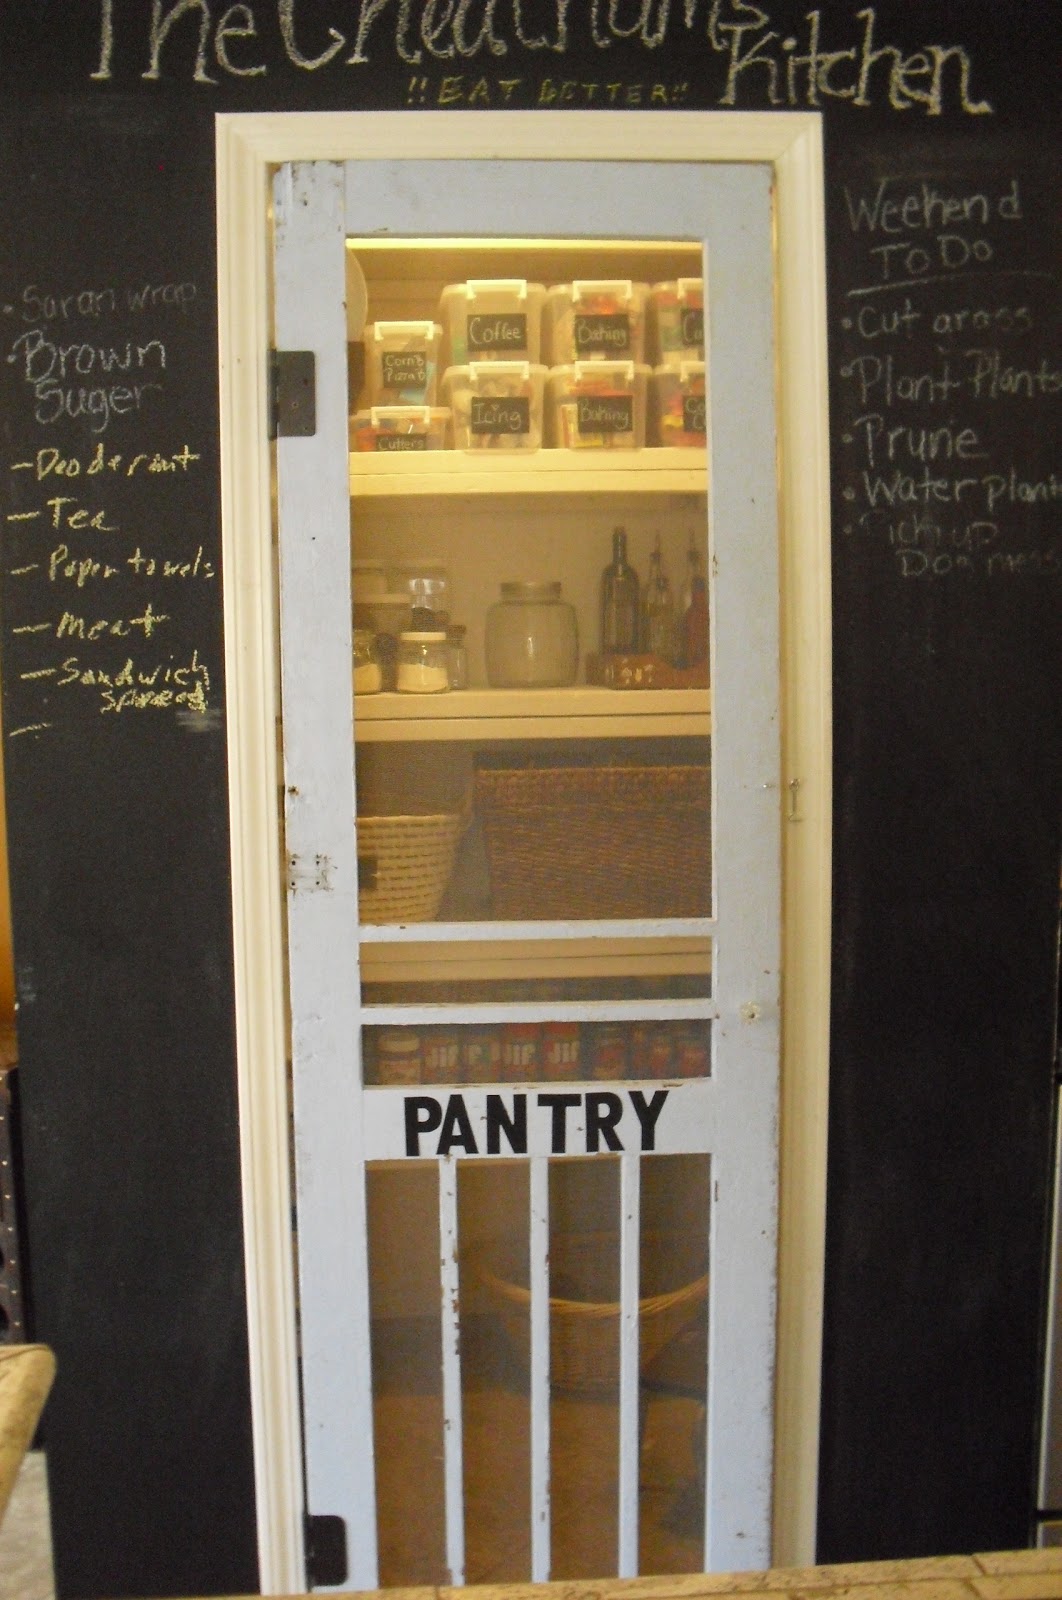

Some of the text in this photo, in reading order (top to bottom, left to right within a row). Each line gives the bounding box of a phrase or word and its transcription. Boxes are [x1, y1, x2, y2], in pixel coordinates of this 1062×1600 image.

[719, 8, 993, 116] Kitchen
[469, 317, 521, 345] Coffee
[858, 299, 920, 339] Cut
[12, 329, 166, 384] Brown
[473, 402, 522, 431] Icing
[853, 413, 990, 469] Prune
[862, 466, 978, 508] Water
[404, 1090, 670, 1157] PANTRY
